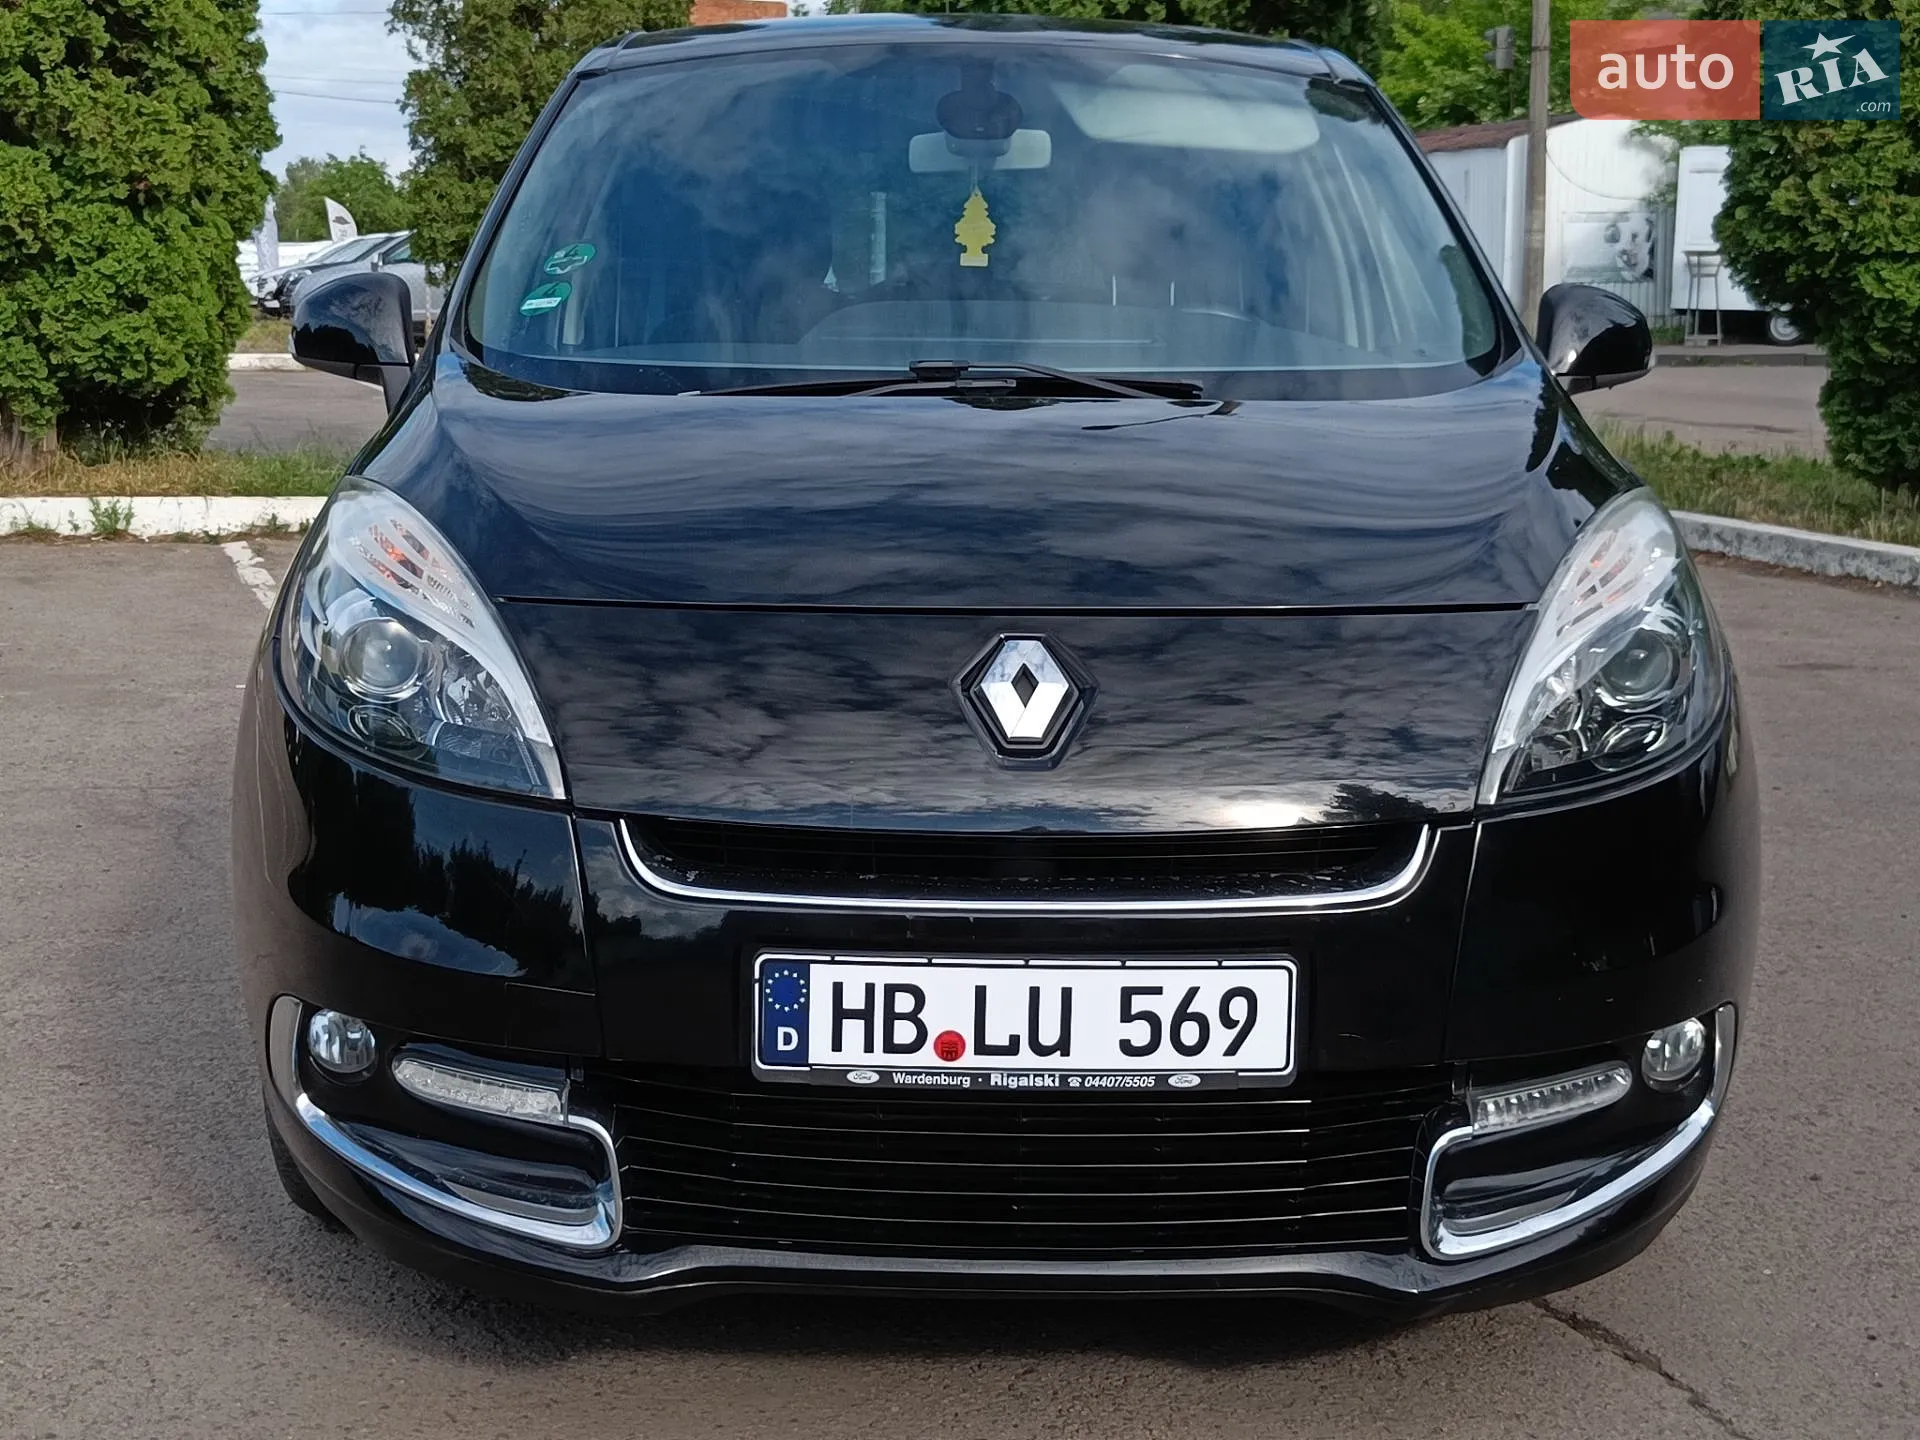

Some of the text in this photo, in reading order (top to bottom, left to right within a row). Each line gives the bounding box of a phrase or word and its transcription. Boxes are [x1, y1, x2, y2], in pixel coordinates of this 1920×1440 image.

[830, 981, 1258, 1058] HB LU 569
[777, 1026, 799, 1051] D
[892, 1072, 1156, 1088] Wardenburg Rigalski 04407/5505
